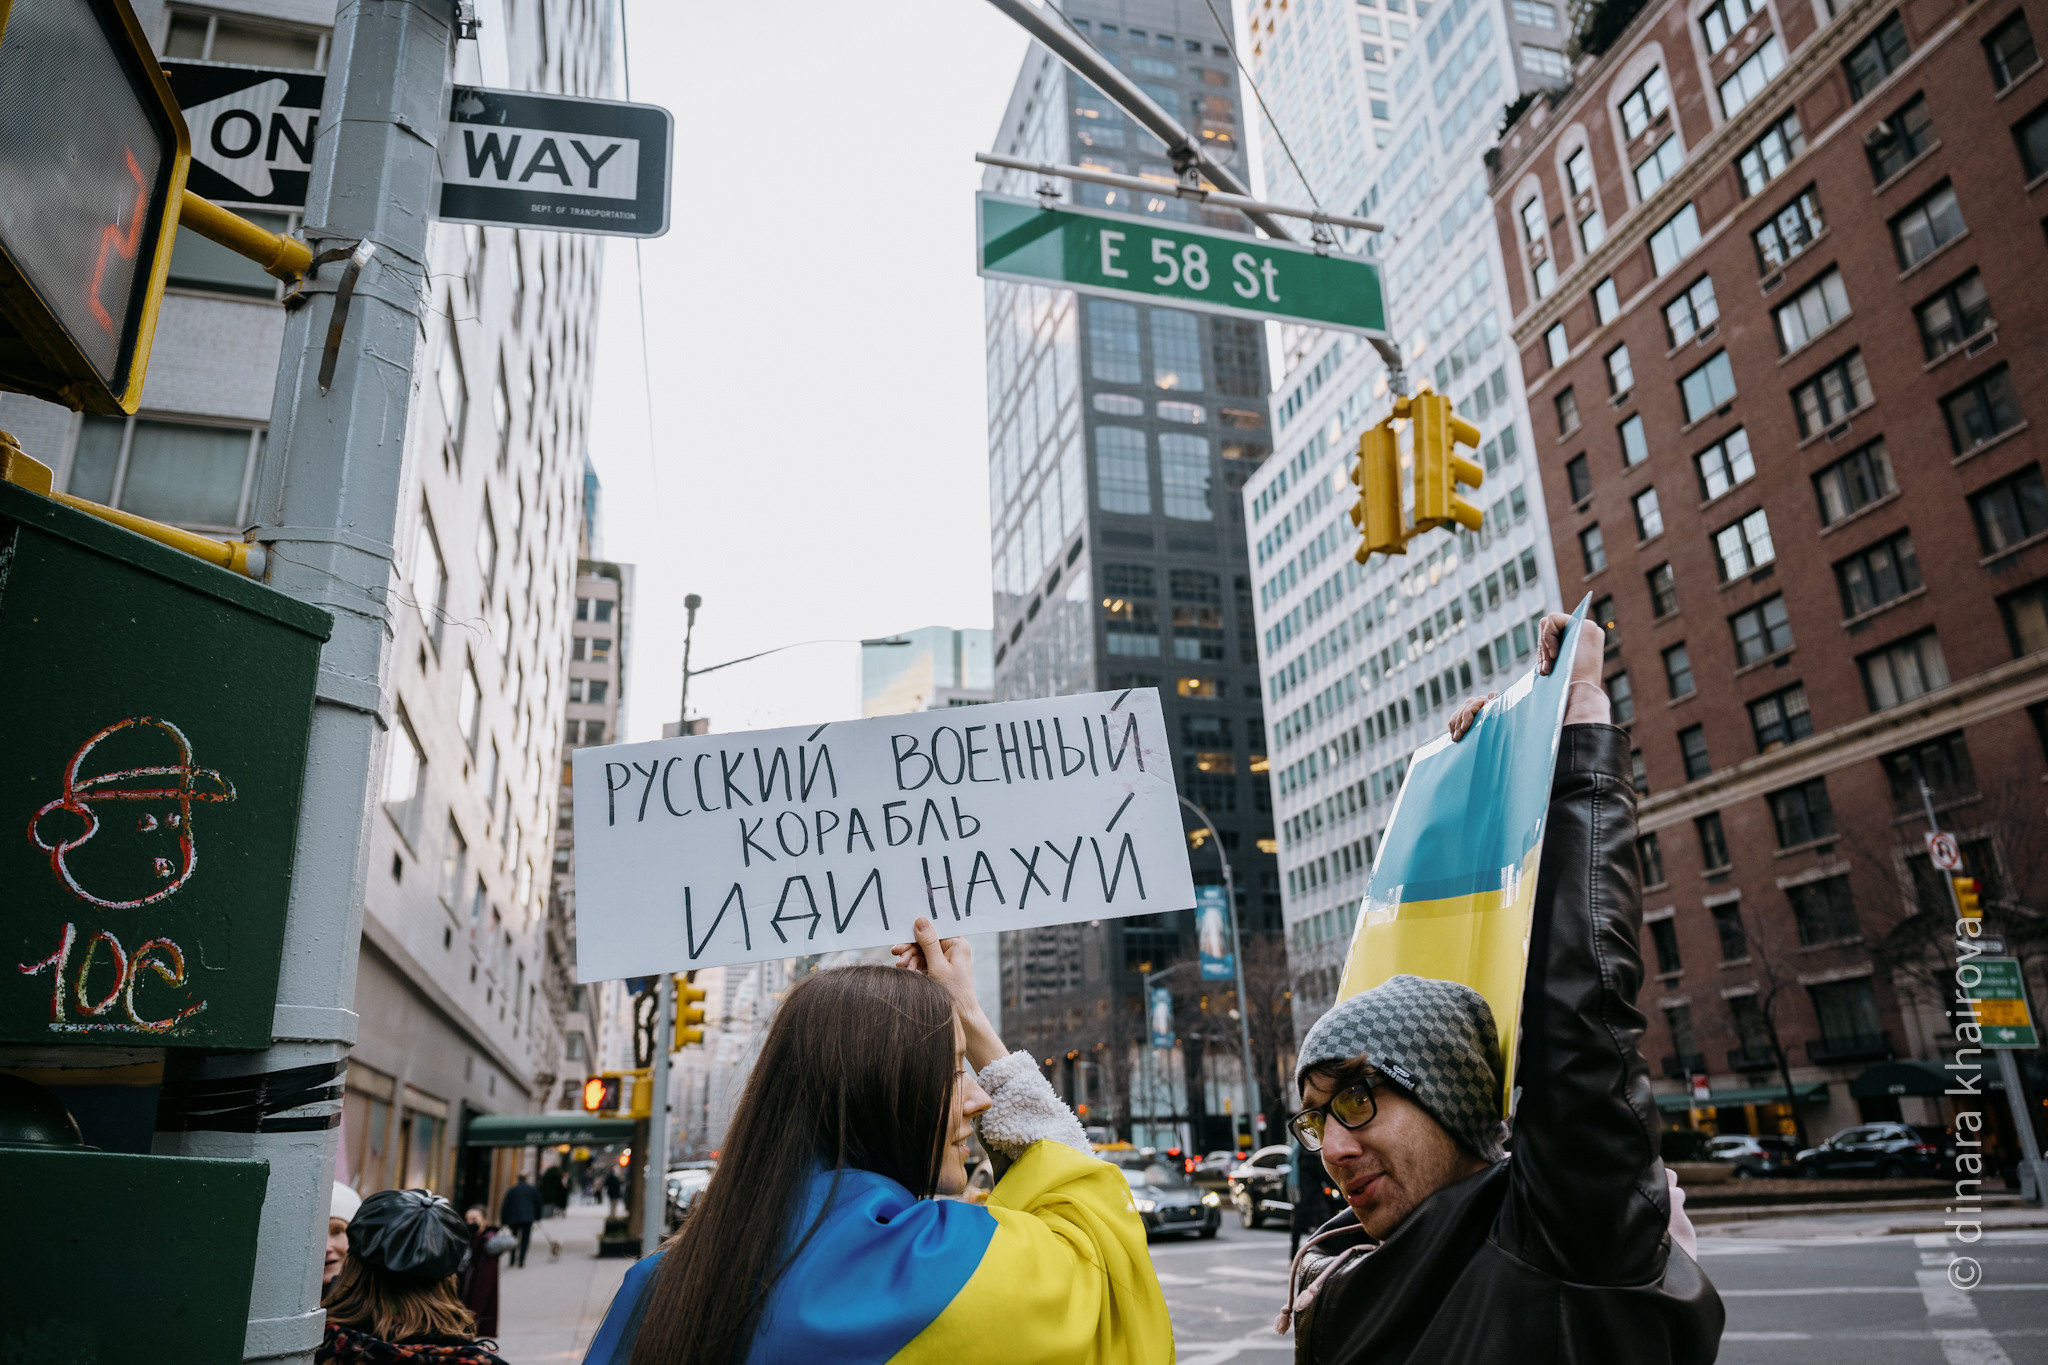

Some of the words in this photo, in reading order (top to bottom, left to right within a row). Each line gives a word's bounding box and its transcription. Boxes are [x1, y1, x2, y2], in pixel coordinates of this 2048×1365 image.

[210, 108, 319, 165] ON
[463, 129, 623, 189] WAY
[530, 203, 552, 214] DEPT
[555, 205, 567, 215] OF
[570, 207, 637, 220] TRANSPORTATION
[1100, 230, 1129, 279] E
[1151, 238, 1211, 291] 58
[1232, 252, 1281, 303] St
[605, 722, 839, 827] РУССКИЙ
[891, 690, 1145, 791] ВОЕННЫЙ
[738, 796, 981, 868] КОРАБЛЬ
[684, 867, 890, 960] ИДИ
[921, 791, 1147, 922] НАХУЙ
